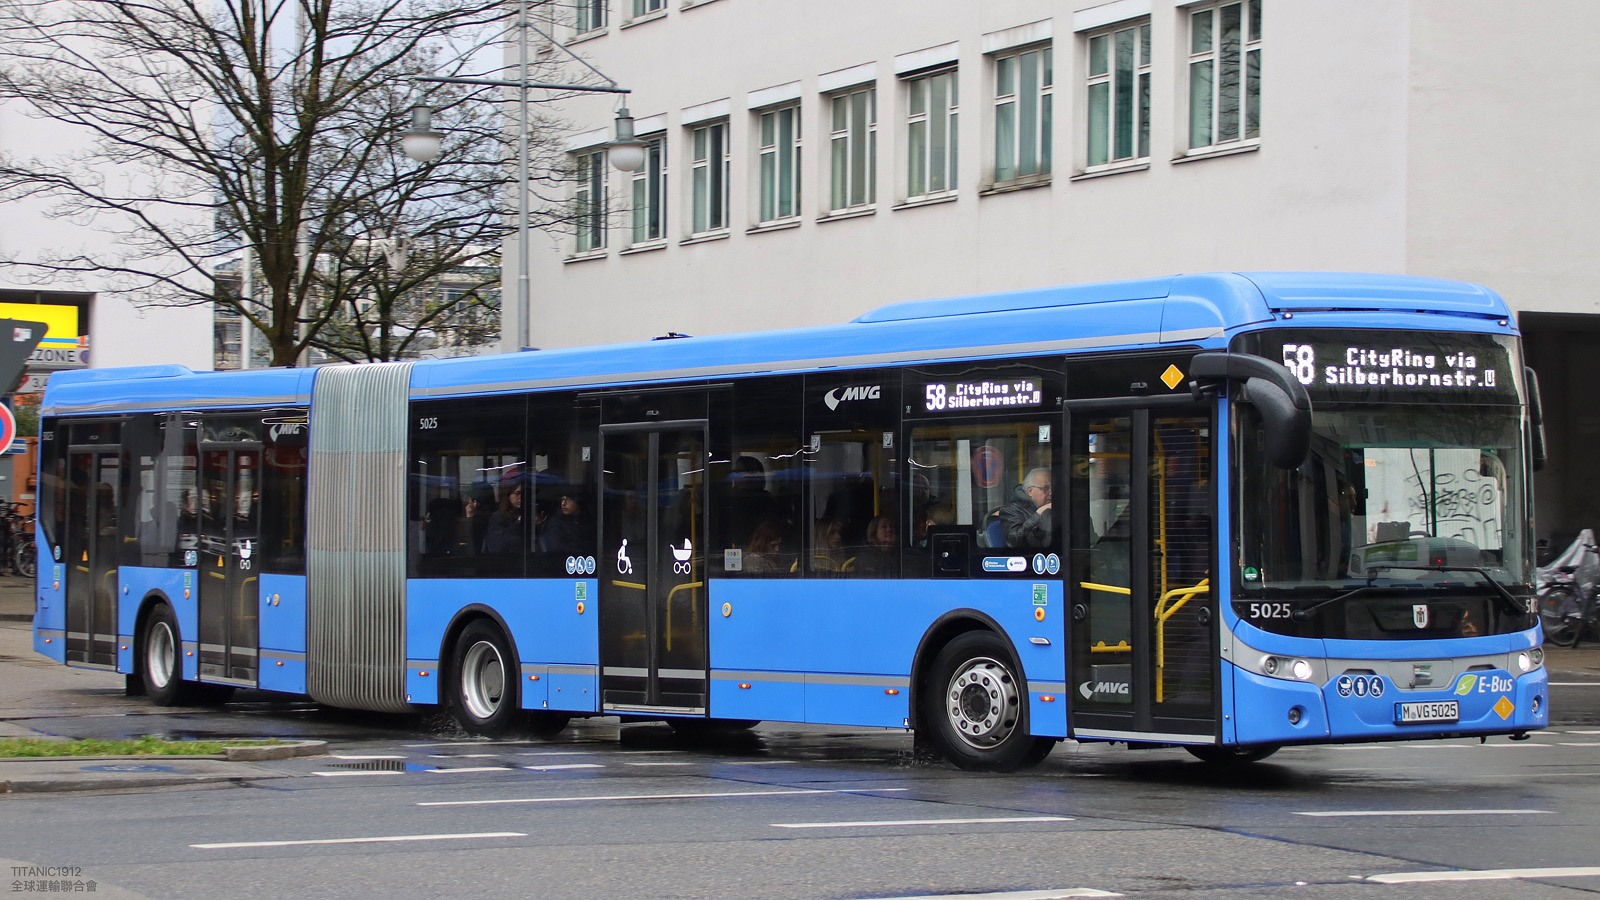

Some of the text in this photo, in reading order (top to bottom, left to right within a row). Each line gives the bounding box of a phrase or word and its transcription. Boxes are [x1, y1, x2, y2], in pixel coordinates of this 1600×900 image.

[1347, 348, 1476, 368] CityRing via
[840, 385, 881, 401] MVG
[956, 381, 1033, 396] CityRing via
[926, 384, 946, 410] 58
[279, 423, 300, 435] MVG
[419, 417, 438, 430] 5025
[1250, 603, 1291, 618] 5025
[1094, 681, 1129, 694] MVG
[1478, 676, 1513, 693] E-Bus
